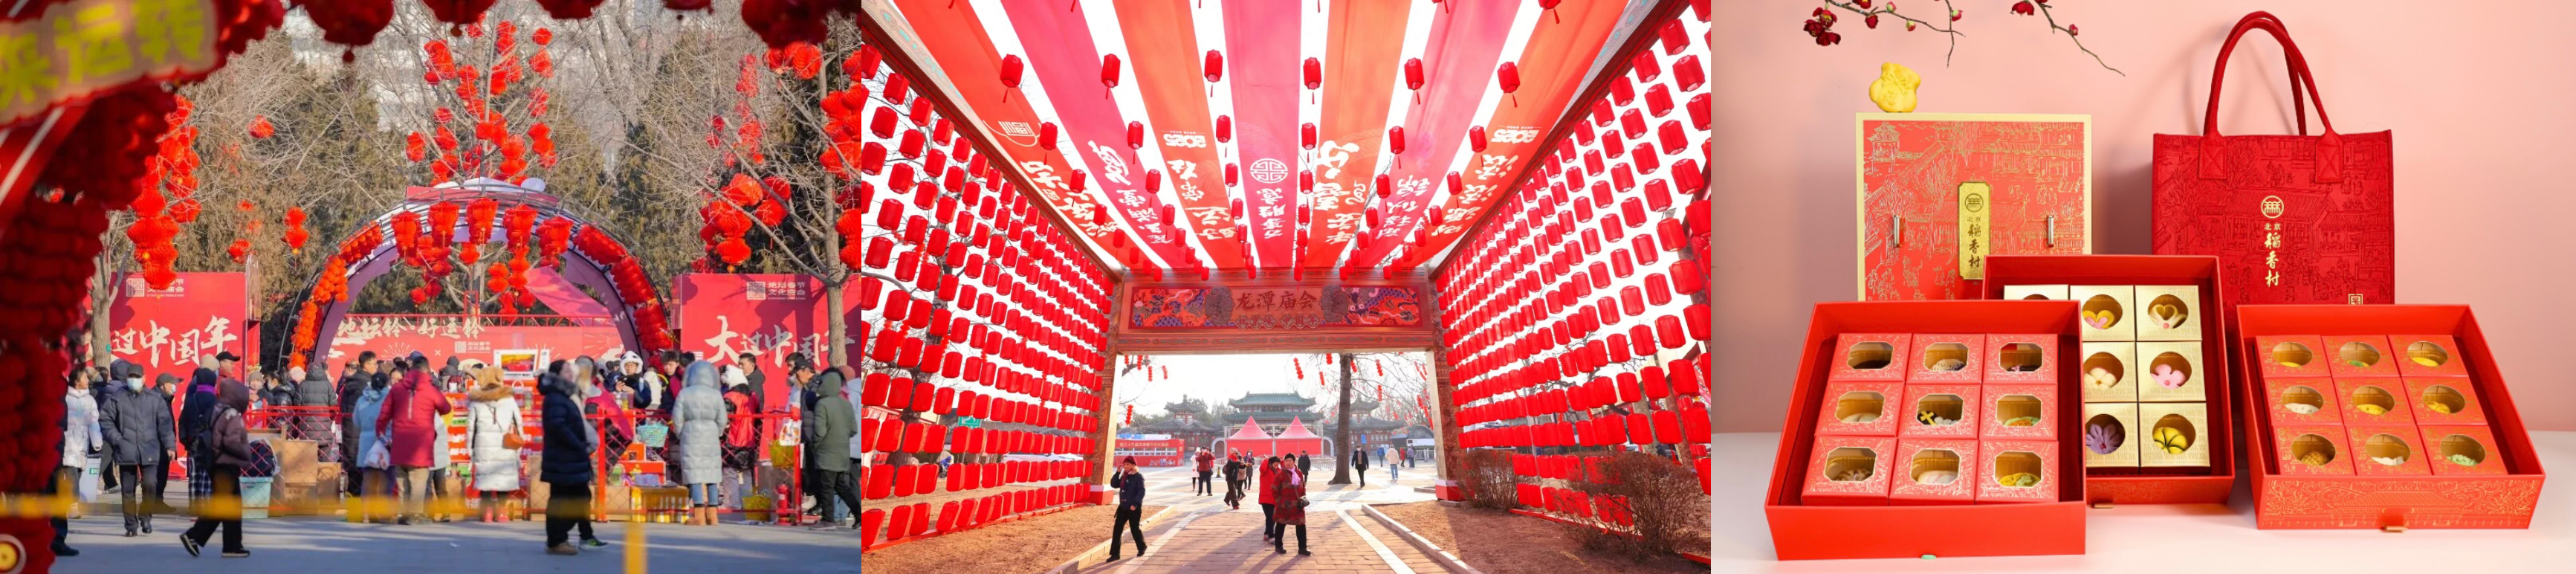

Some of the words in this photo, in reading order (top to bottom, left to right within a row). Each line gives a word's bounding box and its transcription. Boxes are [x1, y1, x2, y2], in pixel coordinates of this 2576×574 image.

[1163, 134, 1207, 148] 2025
[1490, 129, 1539, 144] 2025
[1116, 189, 1174, 244] 金玉满堂
[1166, 159, 1236, 240] 好运常在
[1256, 188, 1286, 239] 万事胜意
[1313, 140, 1362, 245] 平安喜乐
[1431, 154, 1518, 236] 财源滚滚
[1967, 224, 1981, 268] 稻香村
[2264, 232, 2281, 288] 稻香村
[1235, 290, 1317, 312] 龙潭庙会
[1282, 315, 1318, 327] 中国年
